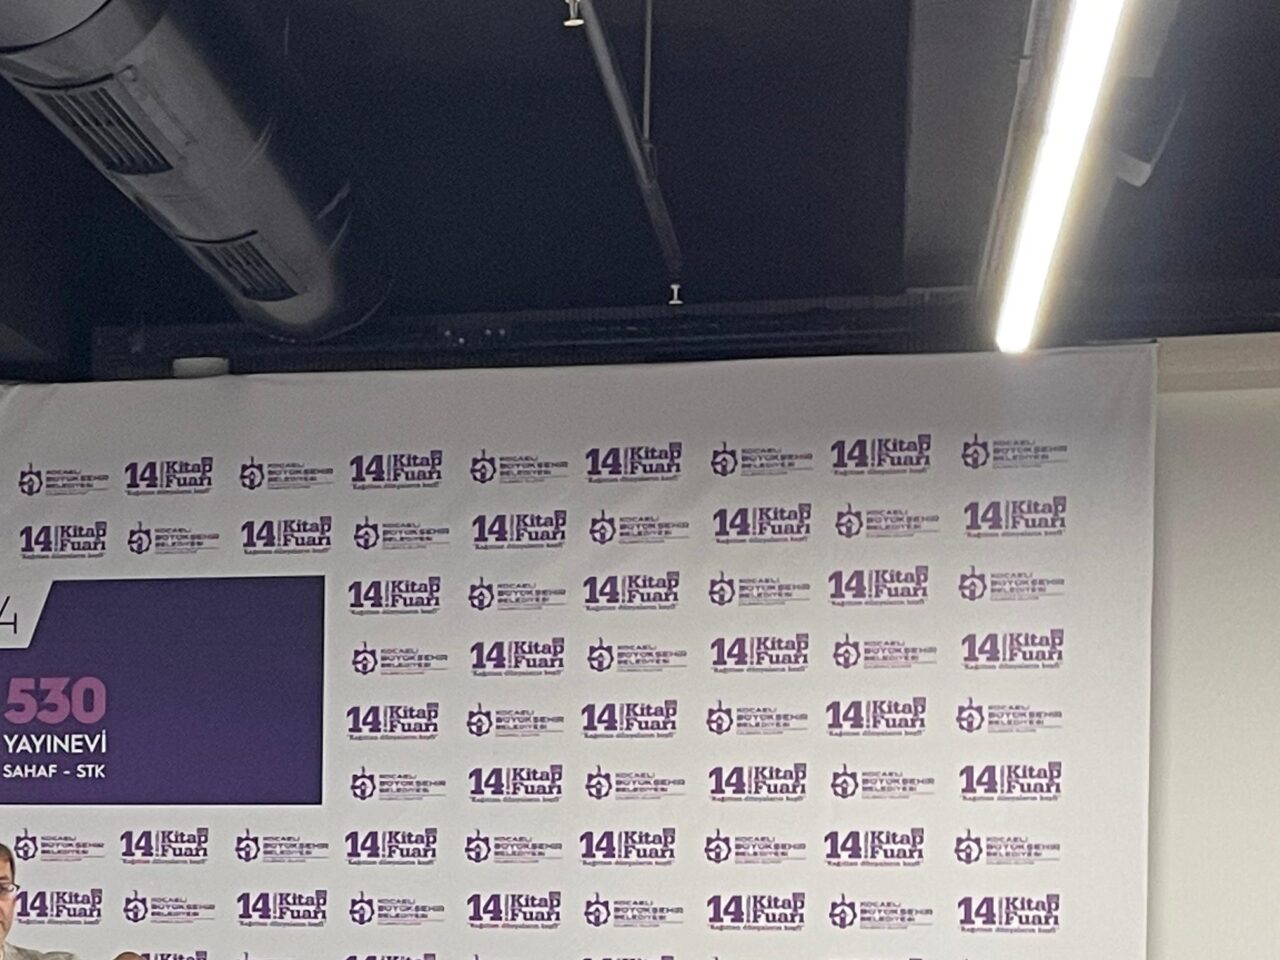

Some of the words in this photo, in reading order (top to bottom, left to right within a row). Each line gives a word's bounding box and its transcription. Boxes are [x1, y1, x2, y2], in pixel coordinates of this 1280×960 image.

[630, 445, 682, 464] Kitap
[831, 439, 868, 467] 14
[876, 436, 932, 456] Kitap
[165, 460, 214, 478] Kitap
[586, 448, 622, 475] 14
[125, 462, 158, 488] 14
[713, 508, 750, 536] 14
[758, 505, 812, 525] Kitap
[241, 521, 275, 547] 14
[282, 519, 332, 537] Kitap
[390, 579, 440, 597] Kitap
[829, 571, 866, 599] 14
[874, 569, 928, 588] Kitap
[348, 581, 383, 608] 14
[711, 638, 748, 665] 14
[755, 636, 808, 655] Kitap
[3, 676, 107, 725] 530
[872, 699, 926, 718] Kitap
[347, 706, 381, 732] 14
[389, 705, 440, 723] Kitap
[826, 701, 863, 729] 14
[3, 729, 107, 753] YAYINEVİ
[2, 764, 57, 778] SAHAF
[76, 764, 106, 778] STK
[959, 765, 997, 793] 14
[1006, 764, 1062, 782] Kitap
[345, 831, 380, 857] 14
[387, 831, 438, 848] Kitap
[824, 831, 862, 858] 14
[870, 830, 924, 849] Kitap
[467, 894, 502, 921] 14
[510, 894, 562, 911] Kitap
[958, 897, 996, 925] 14
[1004, 897, 1060, 915] Kitap
